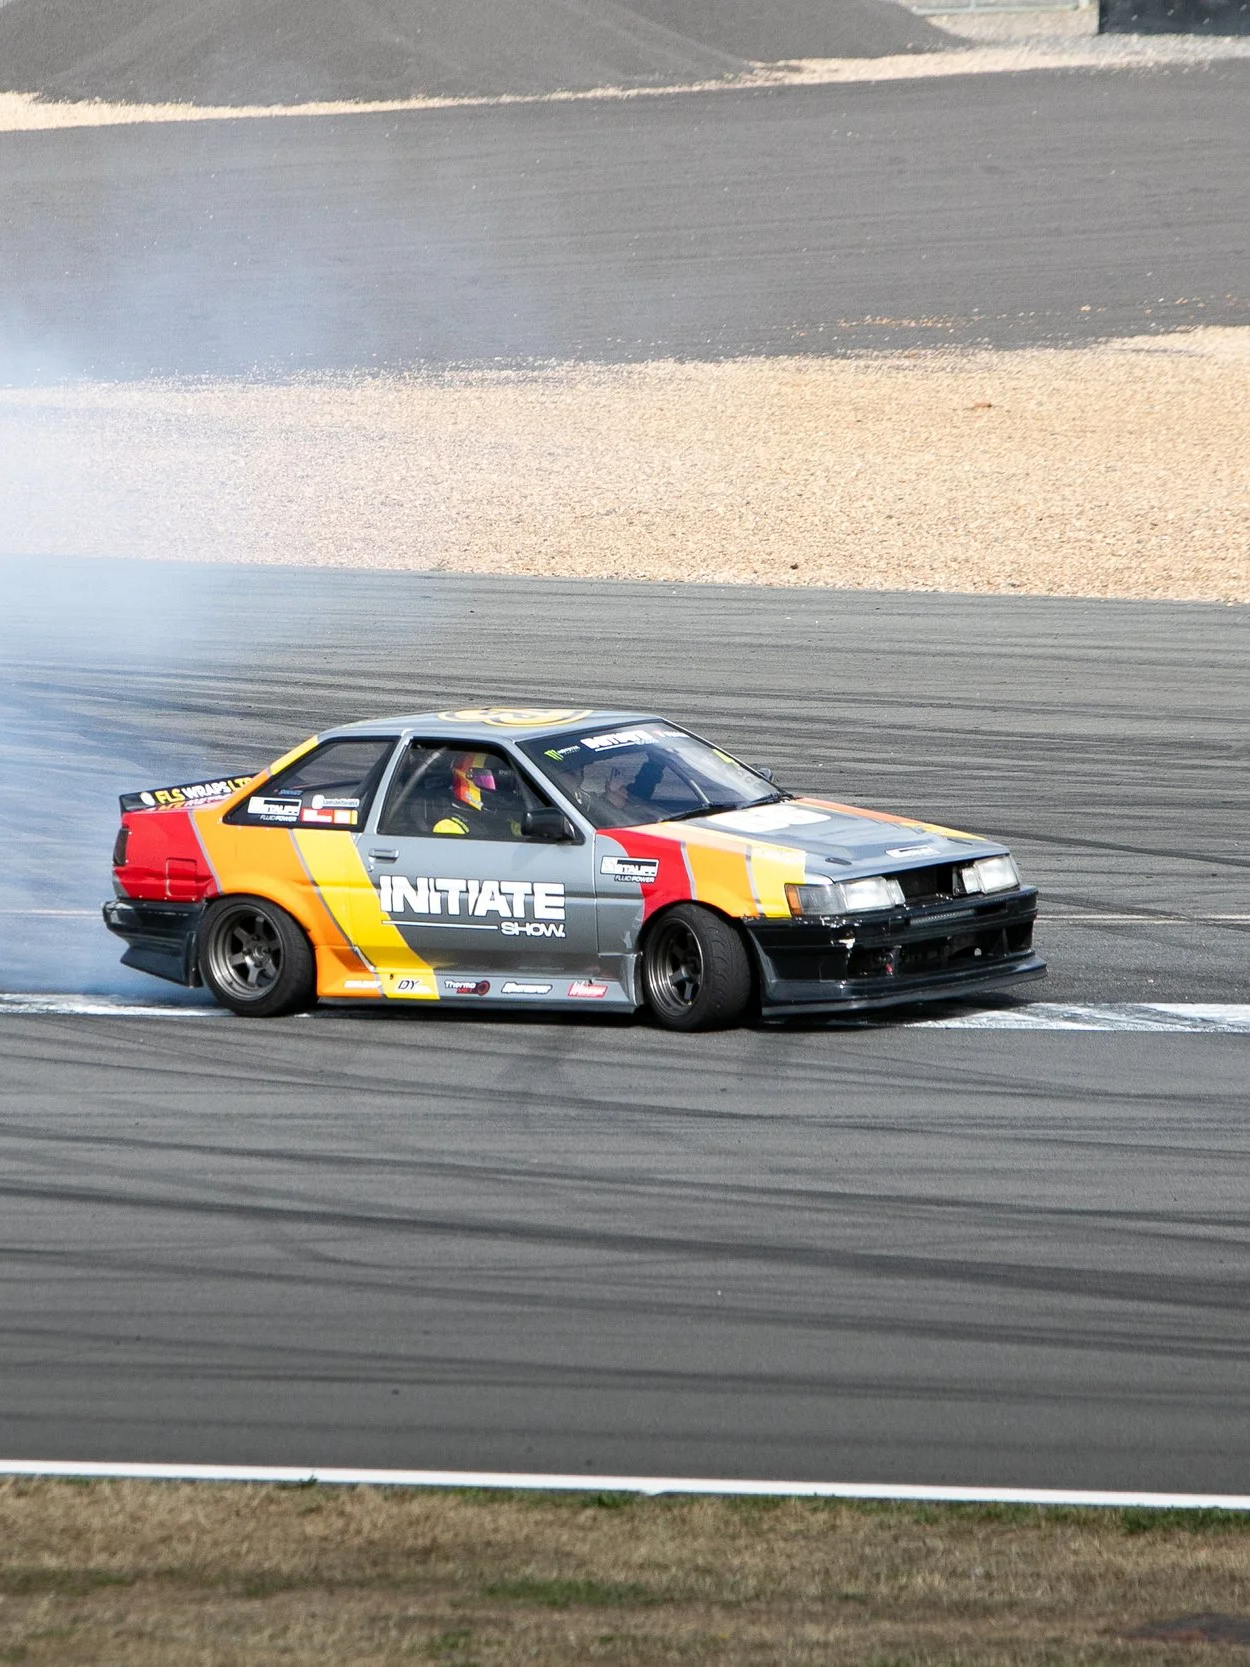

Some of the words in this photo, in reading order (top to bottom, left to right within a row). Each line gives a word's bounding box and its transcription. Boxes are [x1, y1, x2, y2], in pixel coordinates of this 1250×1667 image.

[154, 788, 186, 805] FLS
[181, 781, 231, 799] WRAPS
[379, 875, 566, 920] INITIATE
